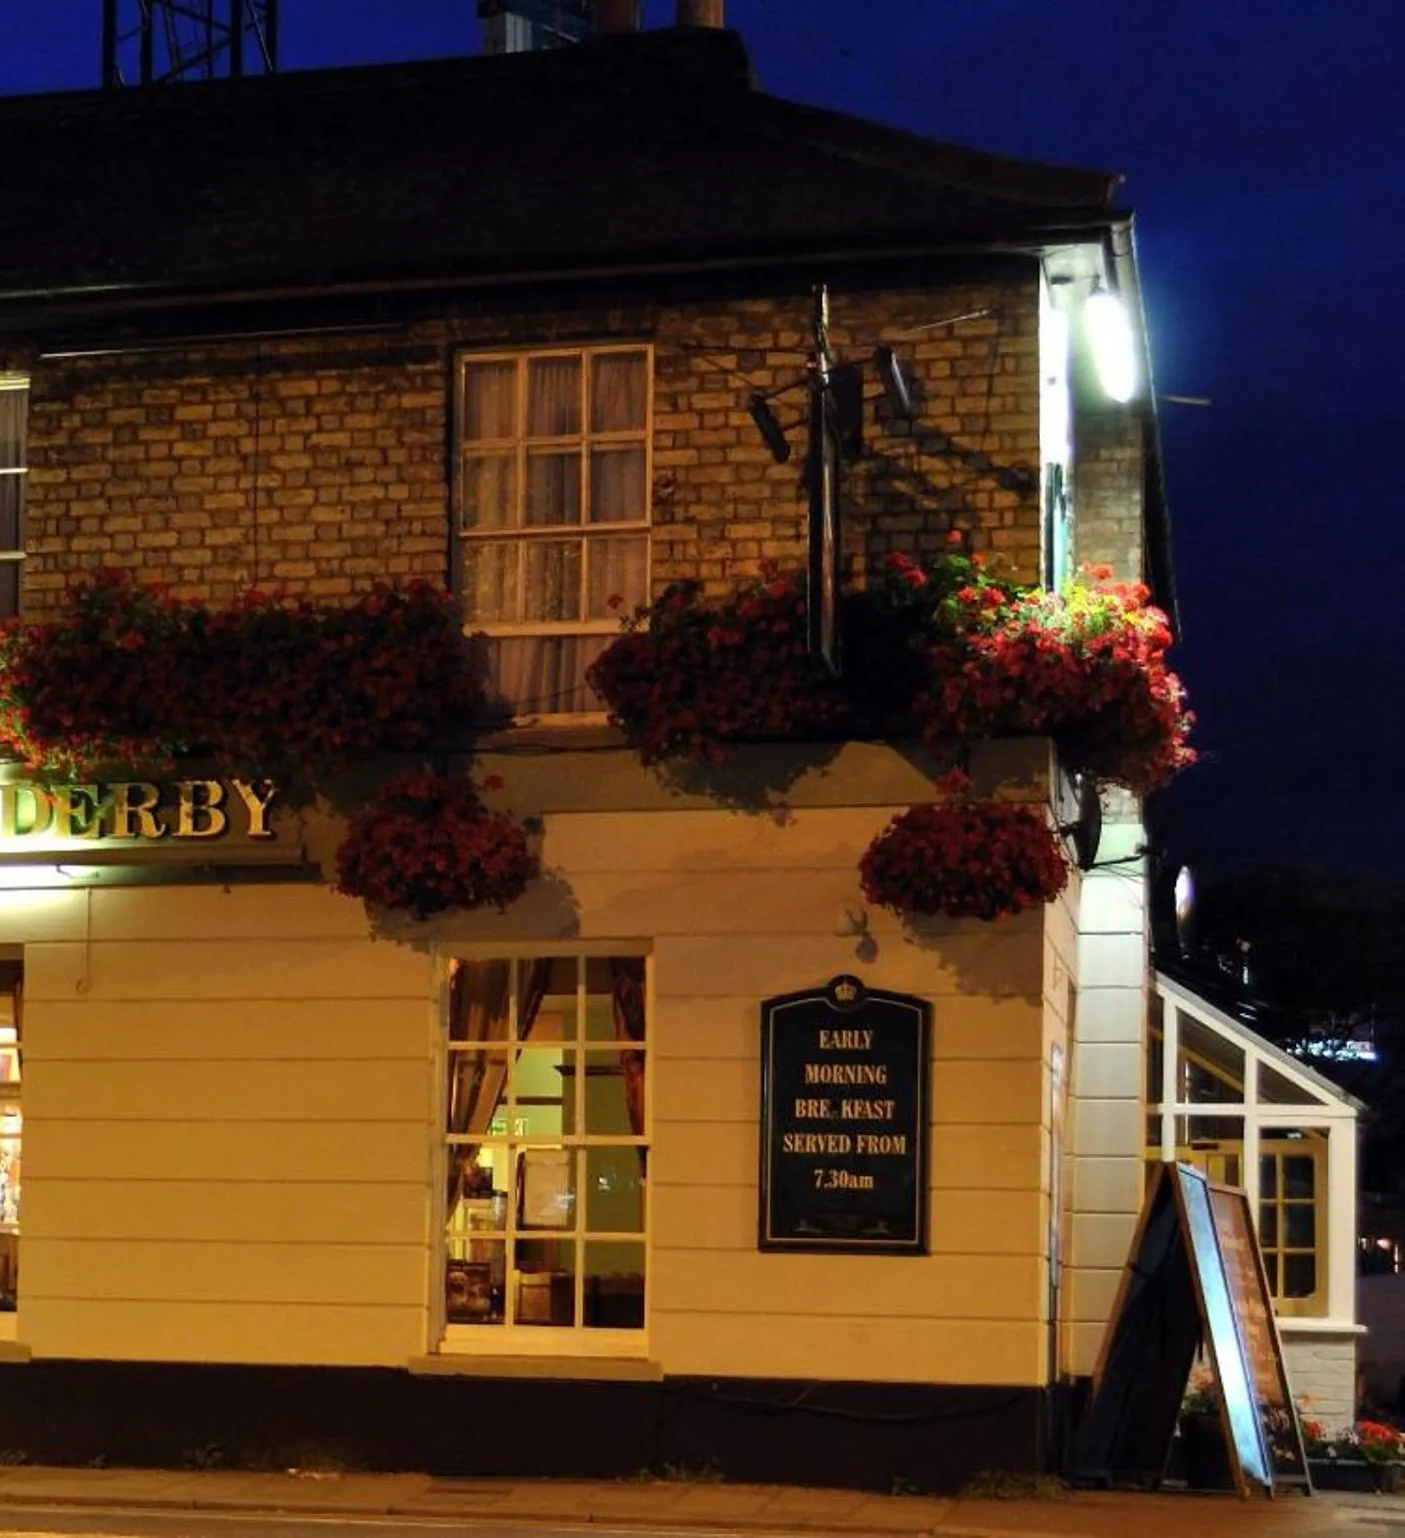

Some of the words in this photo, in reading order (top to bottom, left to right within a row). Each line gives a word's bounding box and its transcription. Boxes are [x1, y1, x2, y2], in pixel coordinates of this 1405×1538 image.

[819, 1029, 873, 1049] EARLY
[805, 1064, 887, 1084] MORNING
[795, 1099, 895, 1119] BREKFAST
[783, 1133, 851, 1153] SERVED
[856, 1135, 906, 1154] FROM
[813, 1169, 874, 1188] 7.30am
